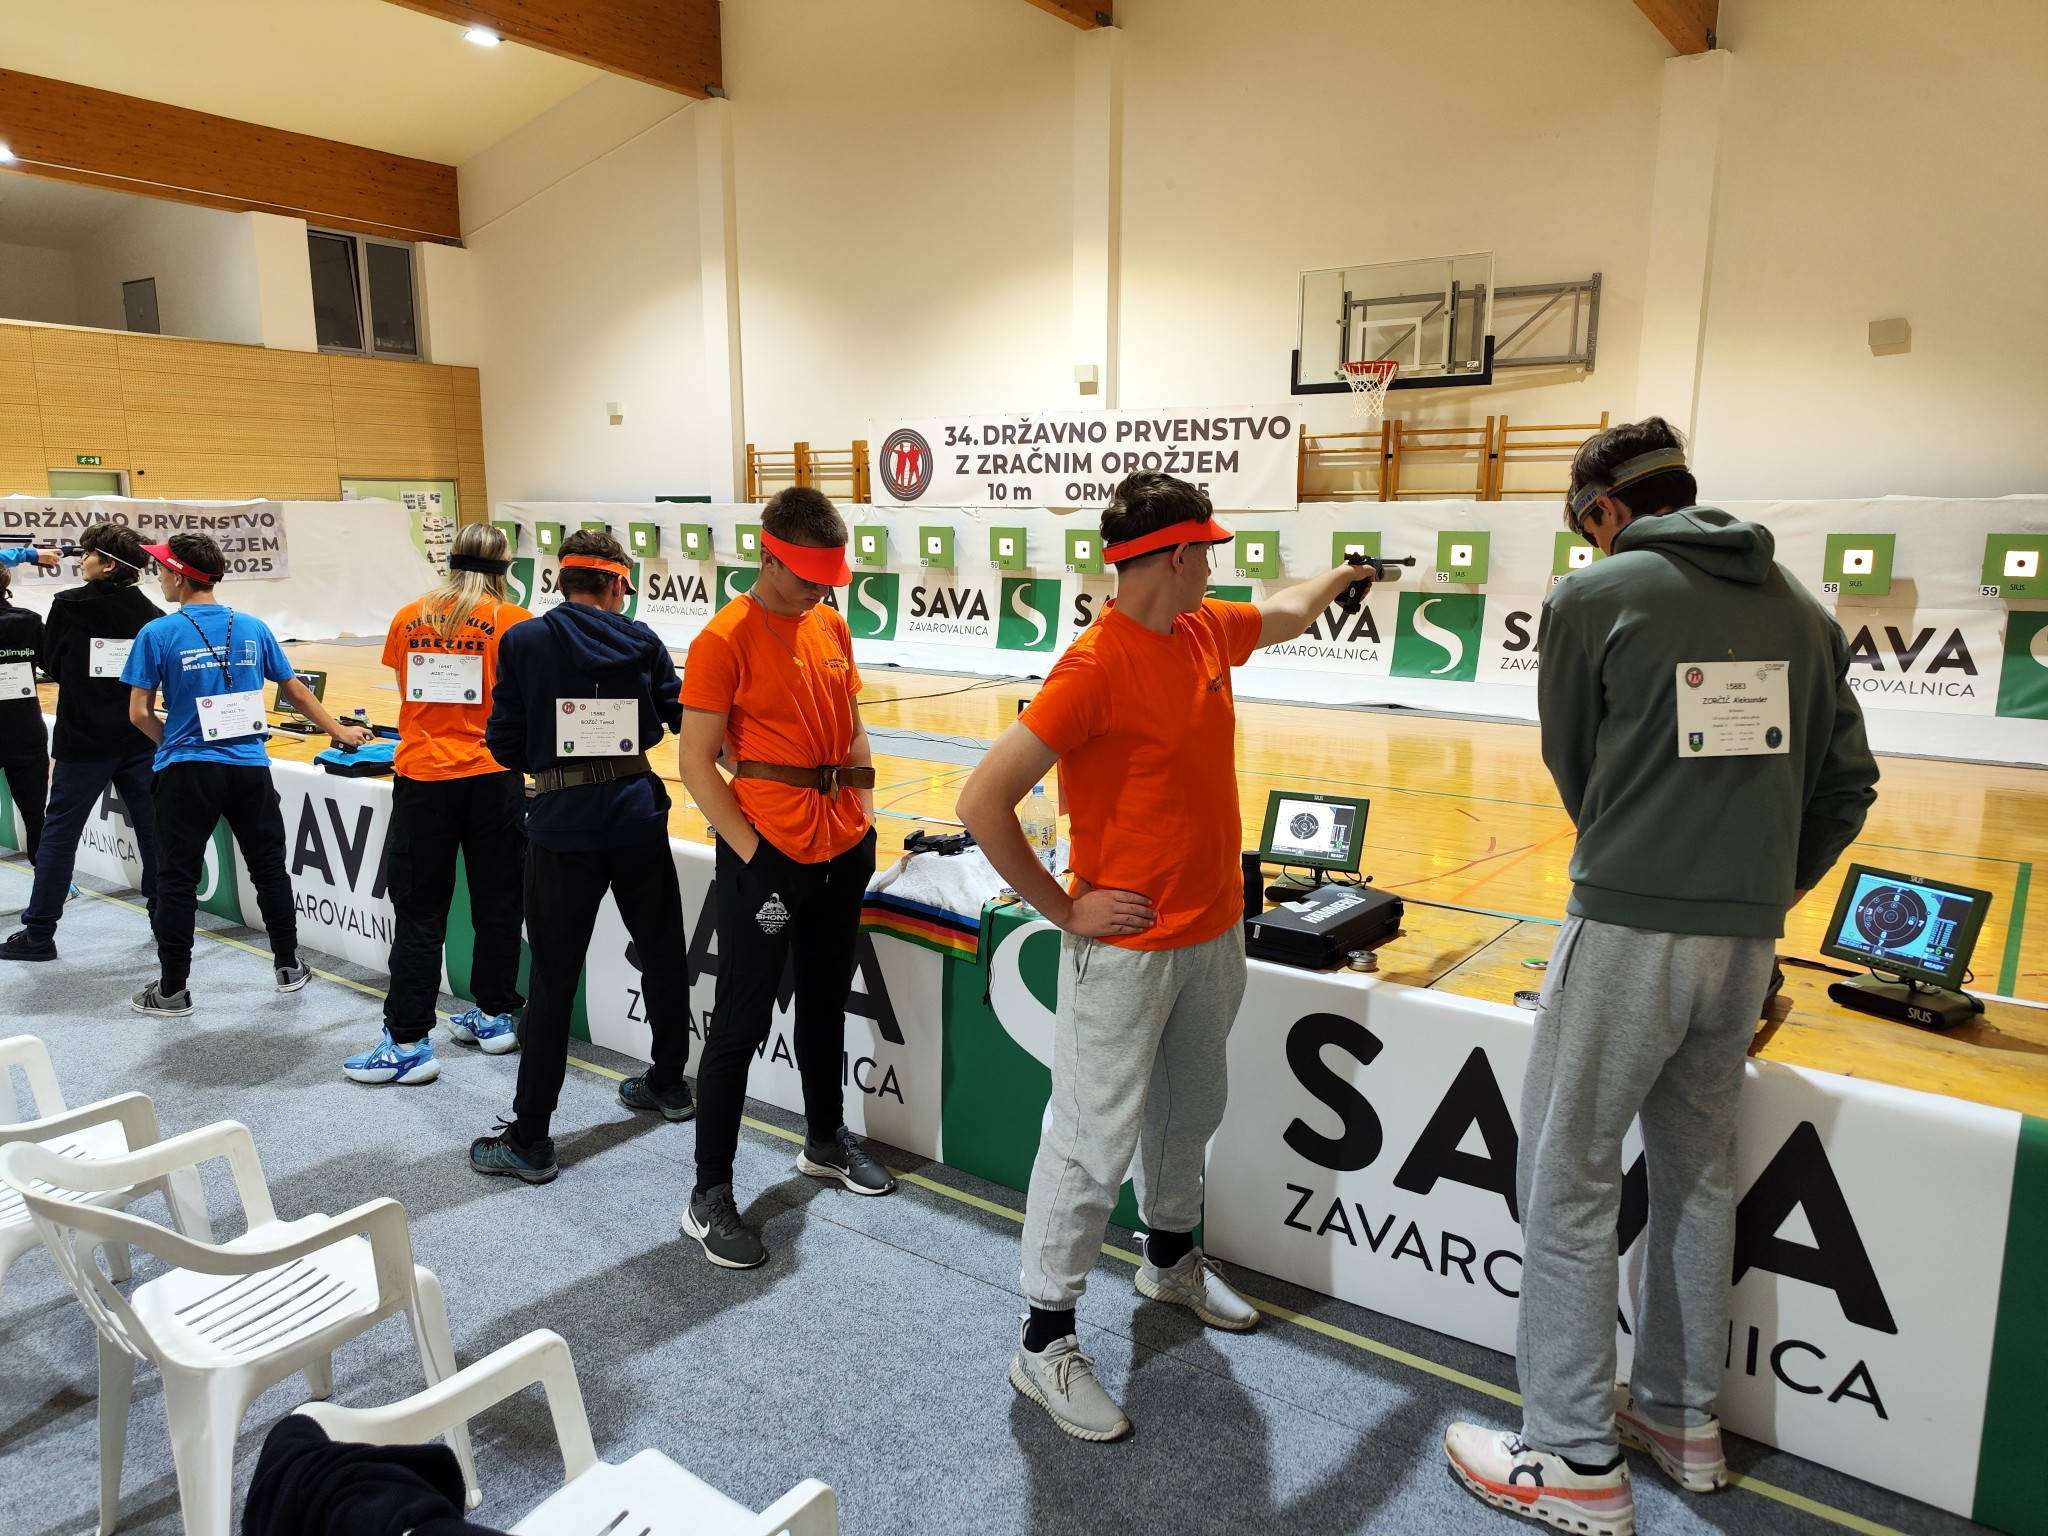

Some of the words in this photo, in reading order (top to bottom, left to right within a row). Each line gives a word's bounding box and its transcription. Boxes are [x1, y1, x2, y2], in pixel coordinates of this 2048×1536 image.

[945, 425, 979, 447] 34.
[983, 417, 1107, 446] DRŽAVNO
[1116, 415, 1292, 443] PRVENSTVO
[956, 454, 970, 475] Z
[977, 446, 1092, 475] ZRAČNIM
[1101, 445, 1239, 474] OROŽJEM
[988, 482, 1007, 501] 10
[1013, 485, 1032, 501] m
[1065, 482, 1115, 501] ORM
[3, 507, 130, 528] DRŽAVNO
[137, 511, 276, 530] PRVENSTVO
[219, 534, 280, 553] ŽJEM
[224, 557, 273, 574] 2025
[990, 561, 999, 569] 50
[1235, 569, 1245, 577] 53
[1437, 573, 1448, 582] 55
[1848, 580, 1863, 588] SIUS
[647, 573, 709, 604] SAVA
[1823, 583, 1838, 593] 58
[1981, 586, 1998, 597] 59
[2010, 583, 2026, 591] SIUS
[646, 604, 708, 617] ZAVAROVALNICA
[910, 586, 990, 622] SAVA
[465, 616, 496, 636] KLUB
[909, 621, 989, 637] ZAVAROVALNICA
[1303, 605, 1381, 644] AVA
[1849, 624, 1979, 676] AVA
[183, 662, 206, 672] Mala
[1725, 682, 1747, 690] 15883
[1849, 677, 1976, 698] ROVALNICA
[1702, 694, 1731, 705] ZORČIČ
[1732, 696, 1768, 704] Aleksander
[1041, 826, 1049, 846] Zala
[81, 827, 138, 865] VALNICA
[292, 791, 394, 900] AV
[1909, 876, 1924, 884] SIUS
[294, 891, 393, 945] AROVALNI
[755, 913, 791, 921] SHONY
[1935, 946, 1943, 956] 6
[1923, 961, 1945, 971] READY
[1907, 1007, 1932, 1024] SIUS
[1282, 1012, 1900, 1337] SAA
